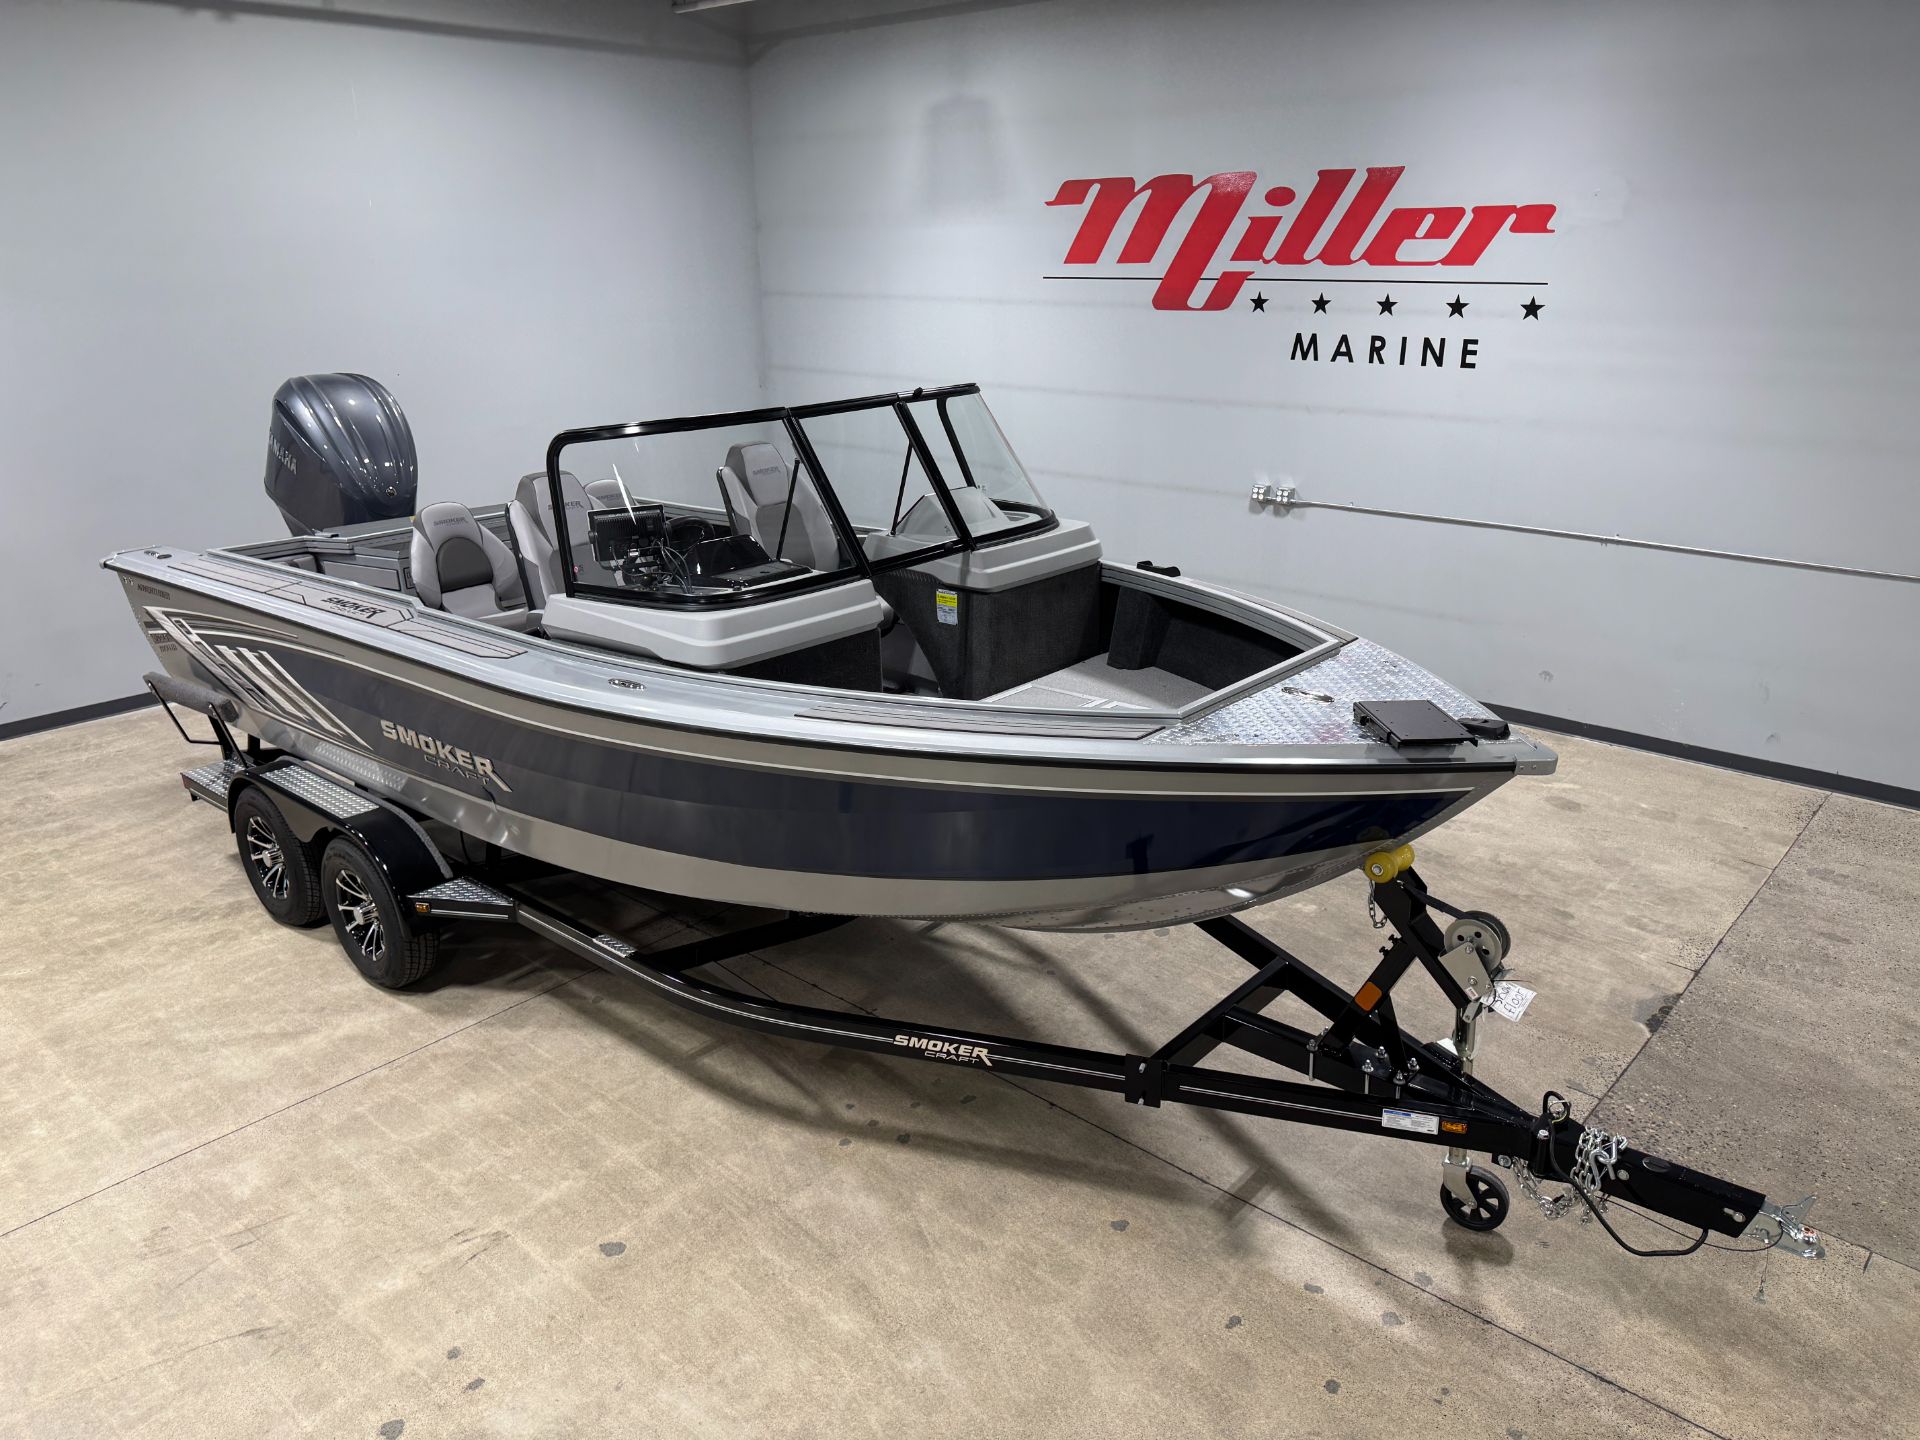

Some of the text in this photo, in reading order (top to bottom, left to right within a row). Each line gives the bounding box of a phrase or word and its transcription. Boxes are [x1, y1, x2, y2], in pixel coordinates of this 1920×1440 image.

[1045, 166, 1556, 311] Miller
[1291, 333, 1479, 369] MARINE
[321, 597, 387, 619] SMOKER
[380, 719, 513, 793] SMOKER
[424, 754, 490, 785] CRAFT
[893, 1034, 993, 1067] SMOKER
[924, 1050, 980, 1064] CRAFT
